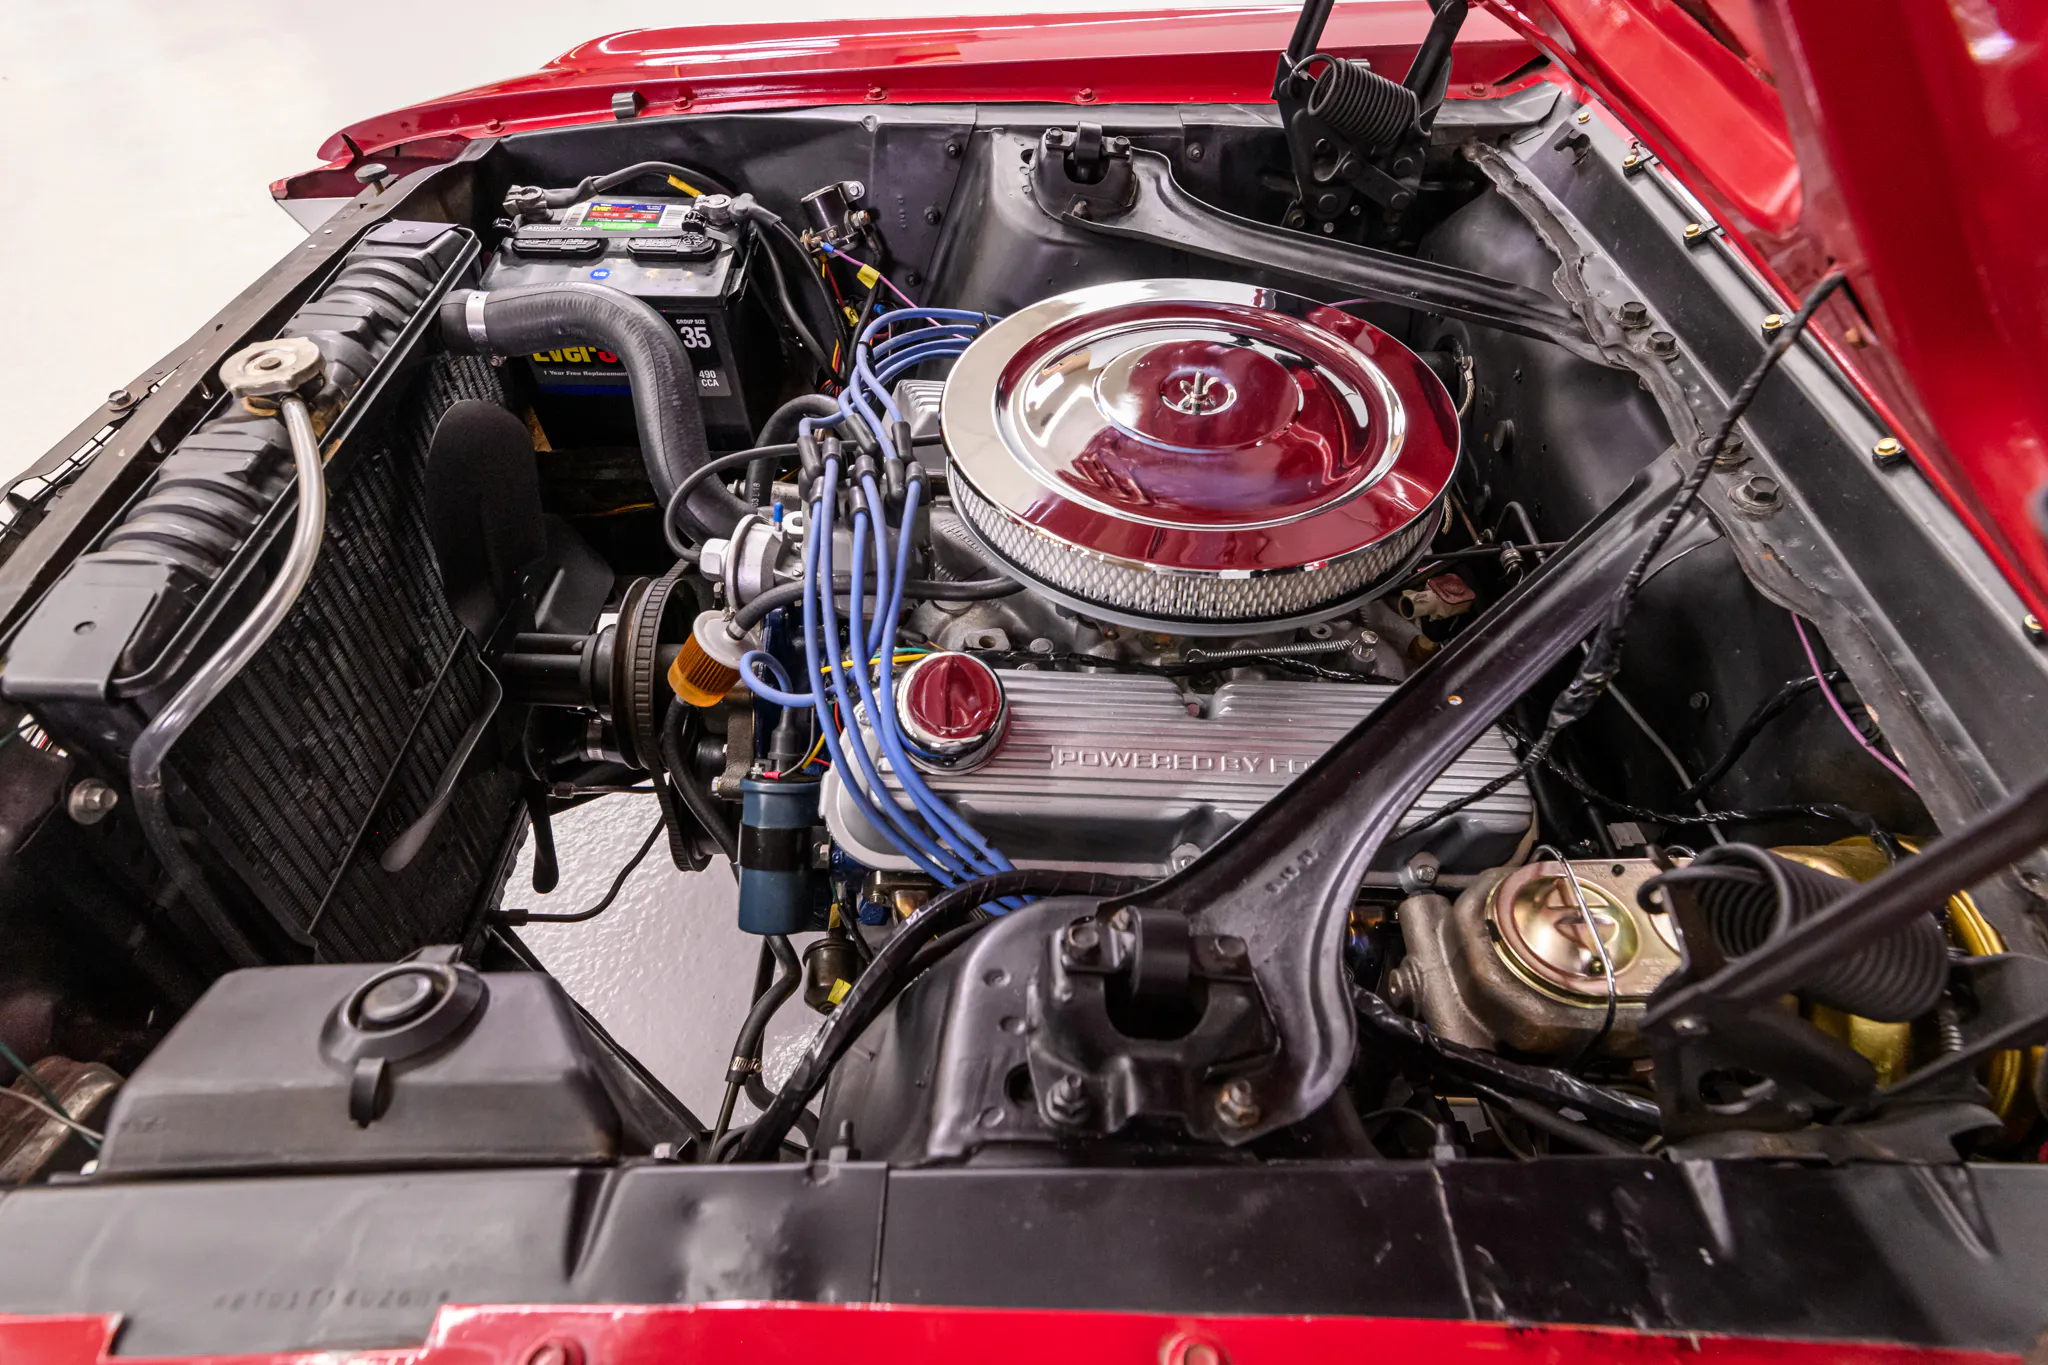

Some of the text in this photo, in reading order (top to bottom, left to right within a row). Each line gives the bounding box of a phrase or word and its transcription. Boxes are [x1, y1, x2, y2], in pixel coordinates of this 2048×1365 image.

[680, 326, 712, 349] 35
[699, 370, 717, 379] 490
[701, 379, 719, 387] CCA
[1058, 749, 1214, 771] POWERED
[1221, 755, 1262, 773] BY
